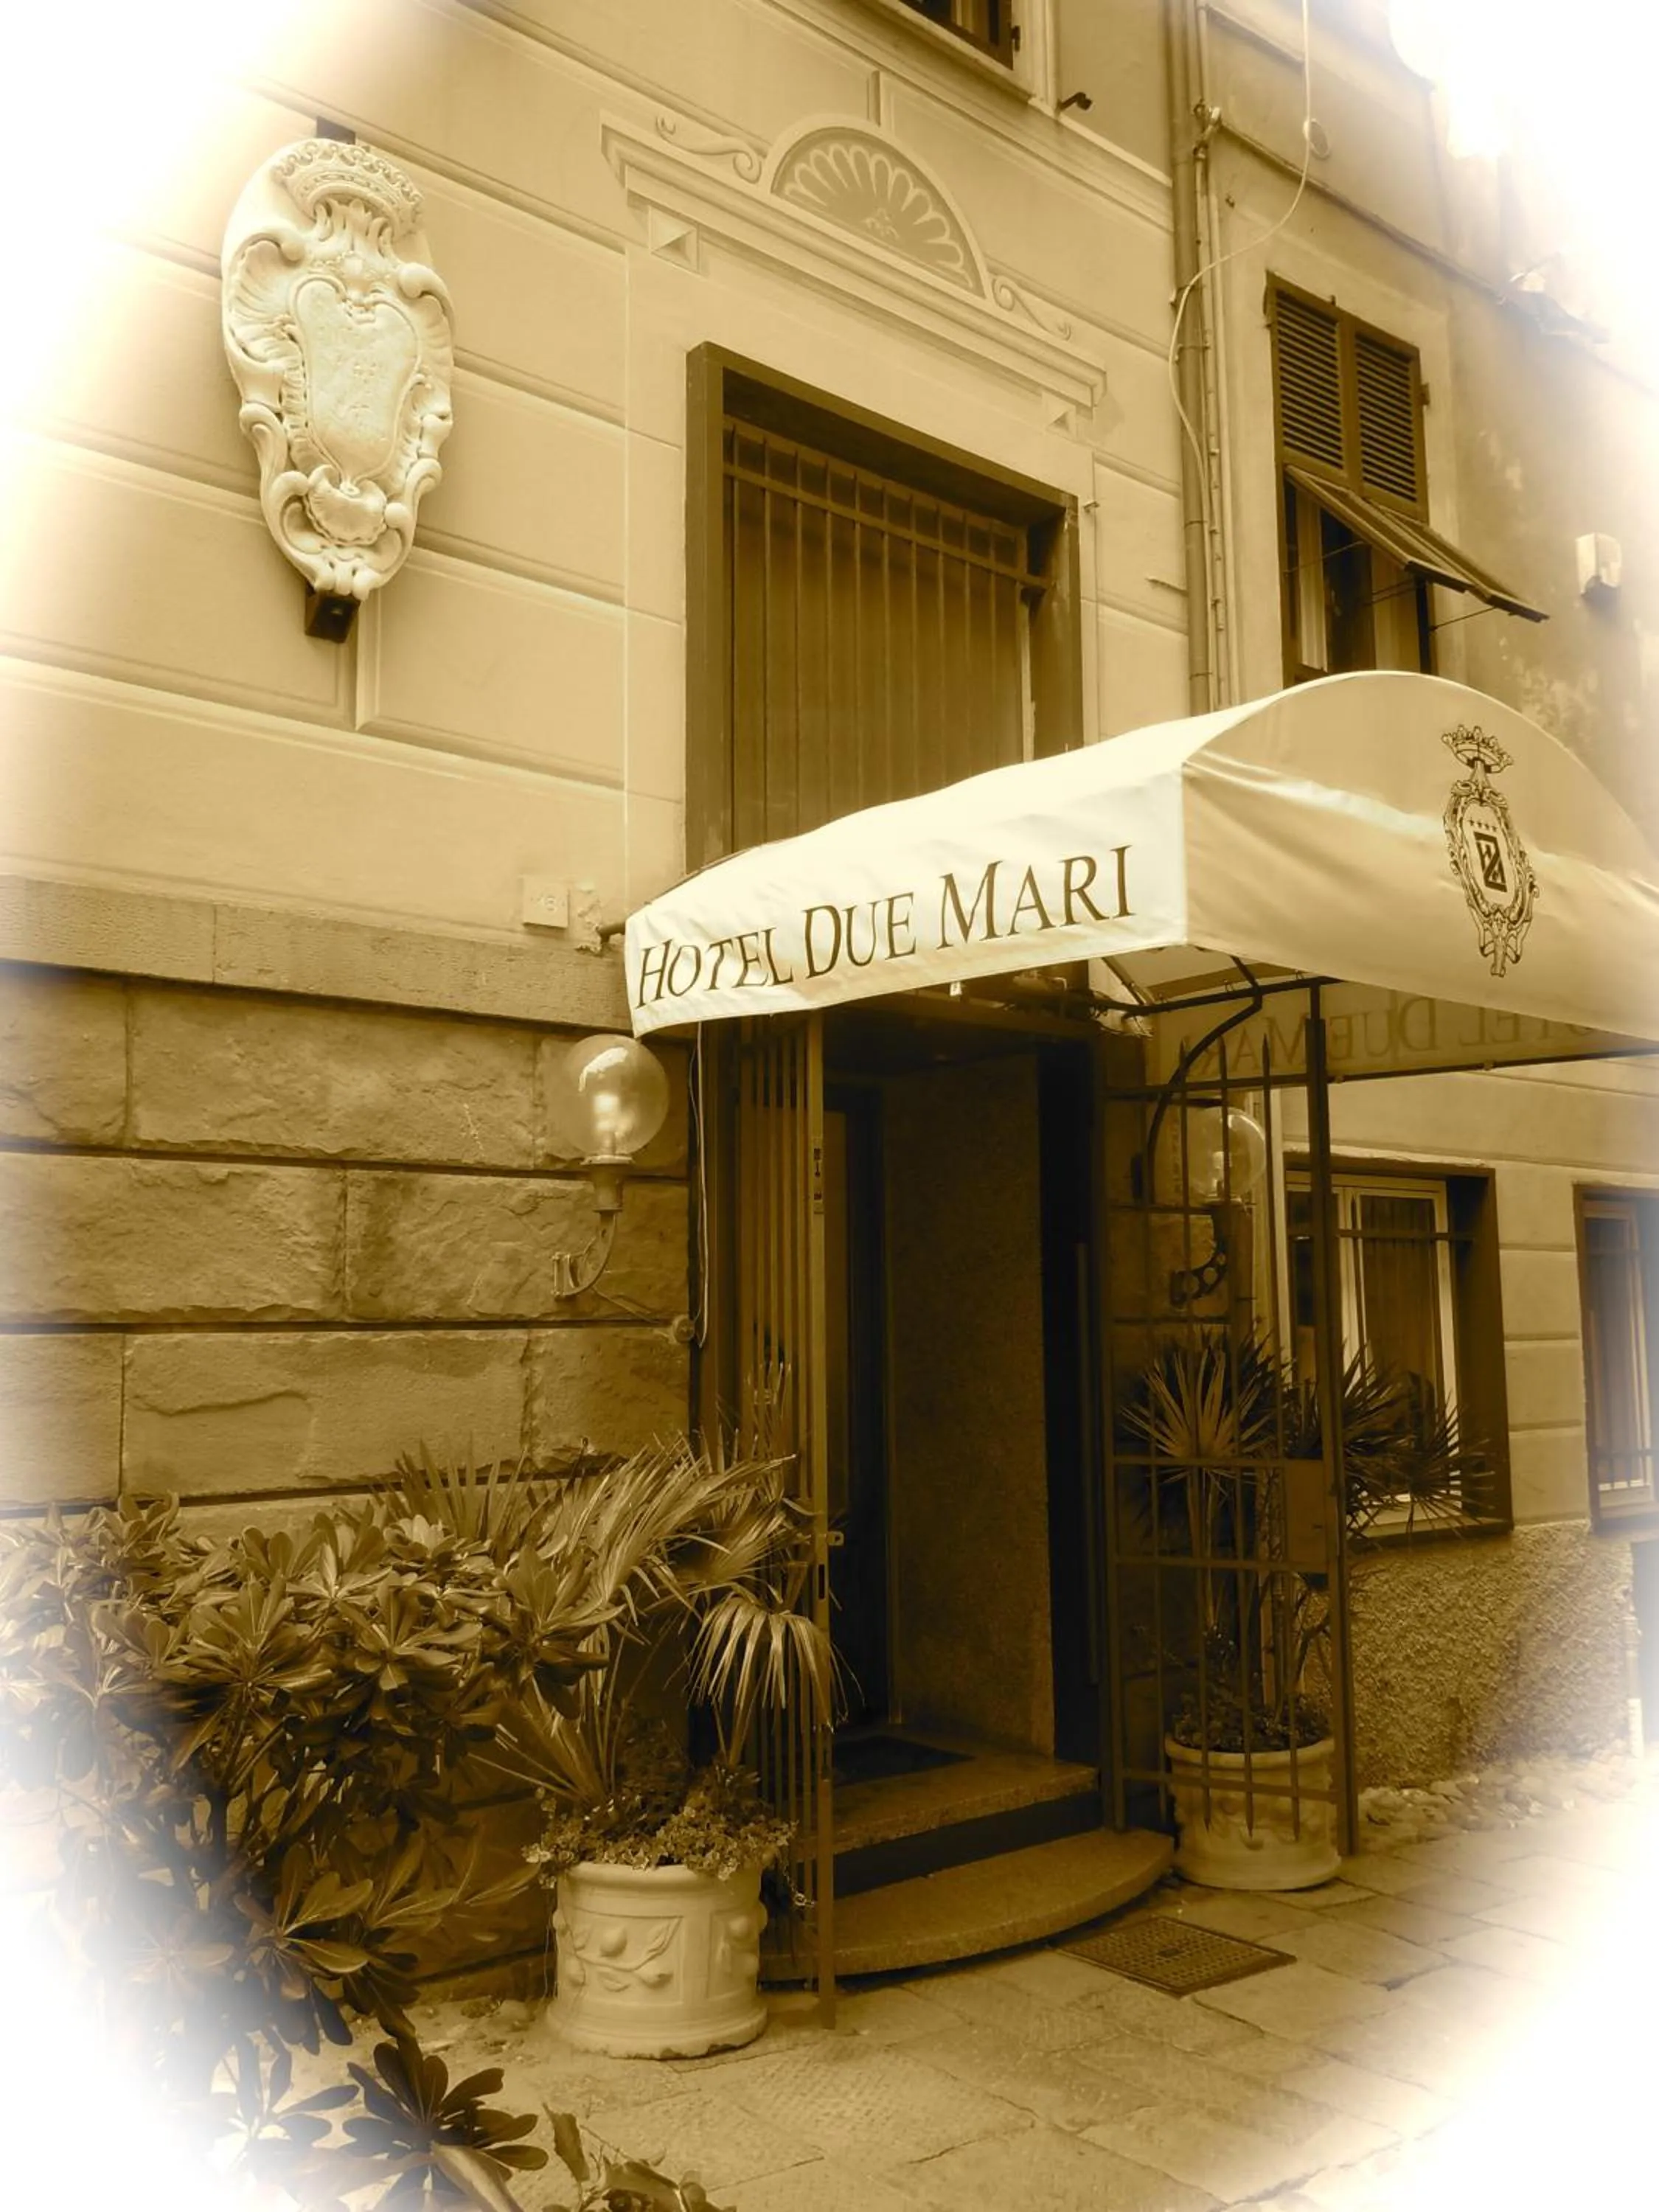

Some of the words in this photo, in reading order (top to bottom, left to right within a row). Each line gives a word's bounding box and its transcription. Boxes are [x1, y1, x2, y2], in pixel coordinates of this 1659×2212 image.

[636, 926, 795, 1009] HOTEL
[801, 891, 917, 981] DUE
[936, 844, 1138, 950] MARI
